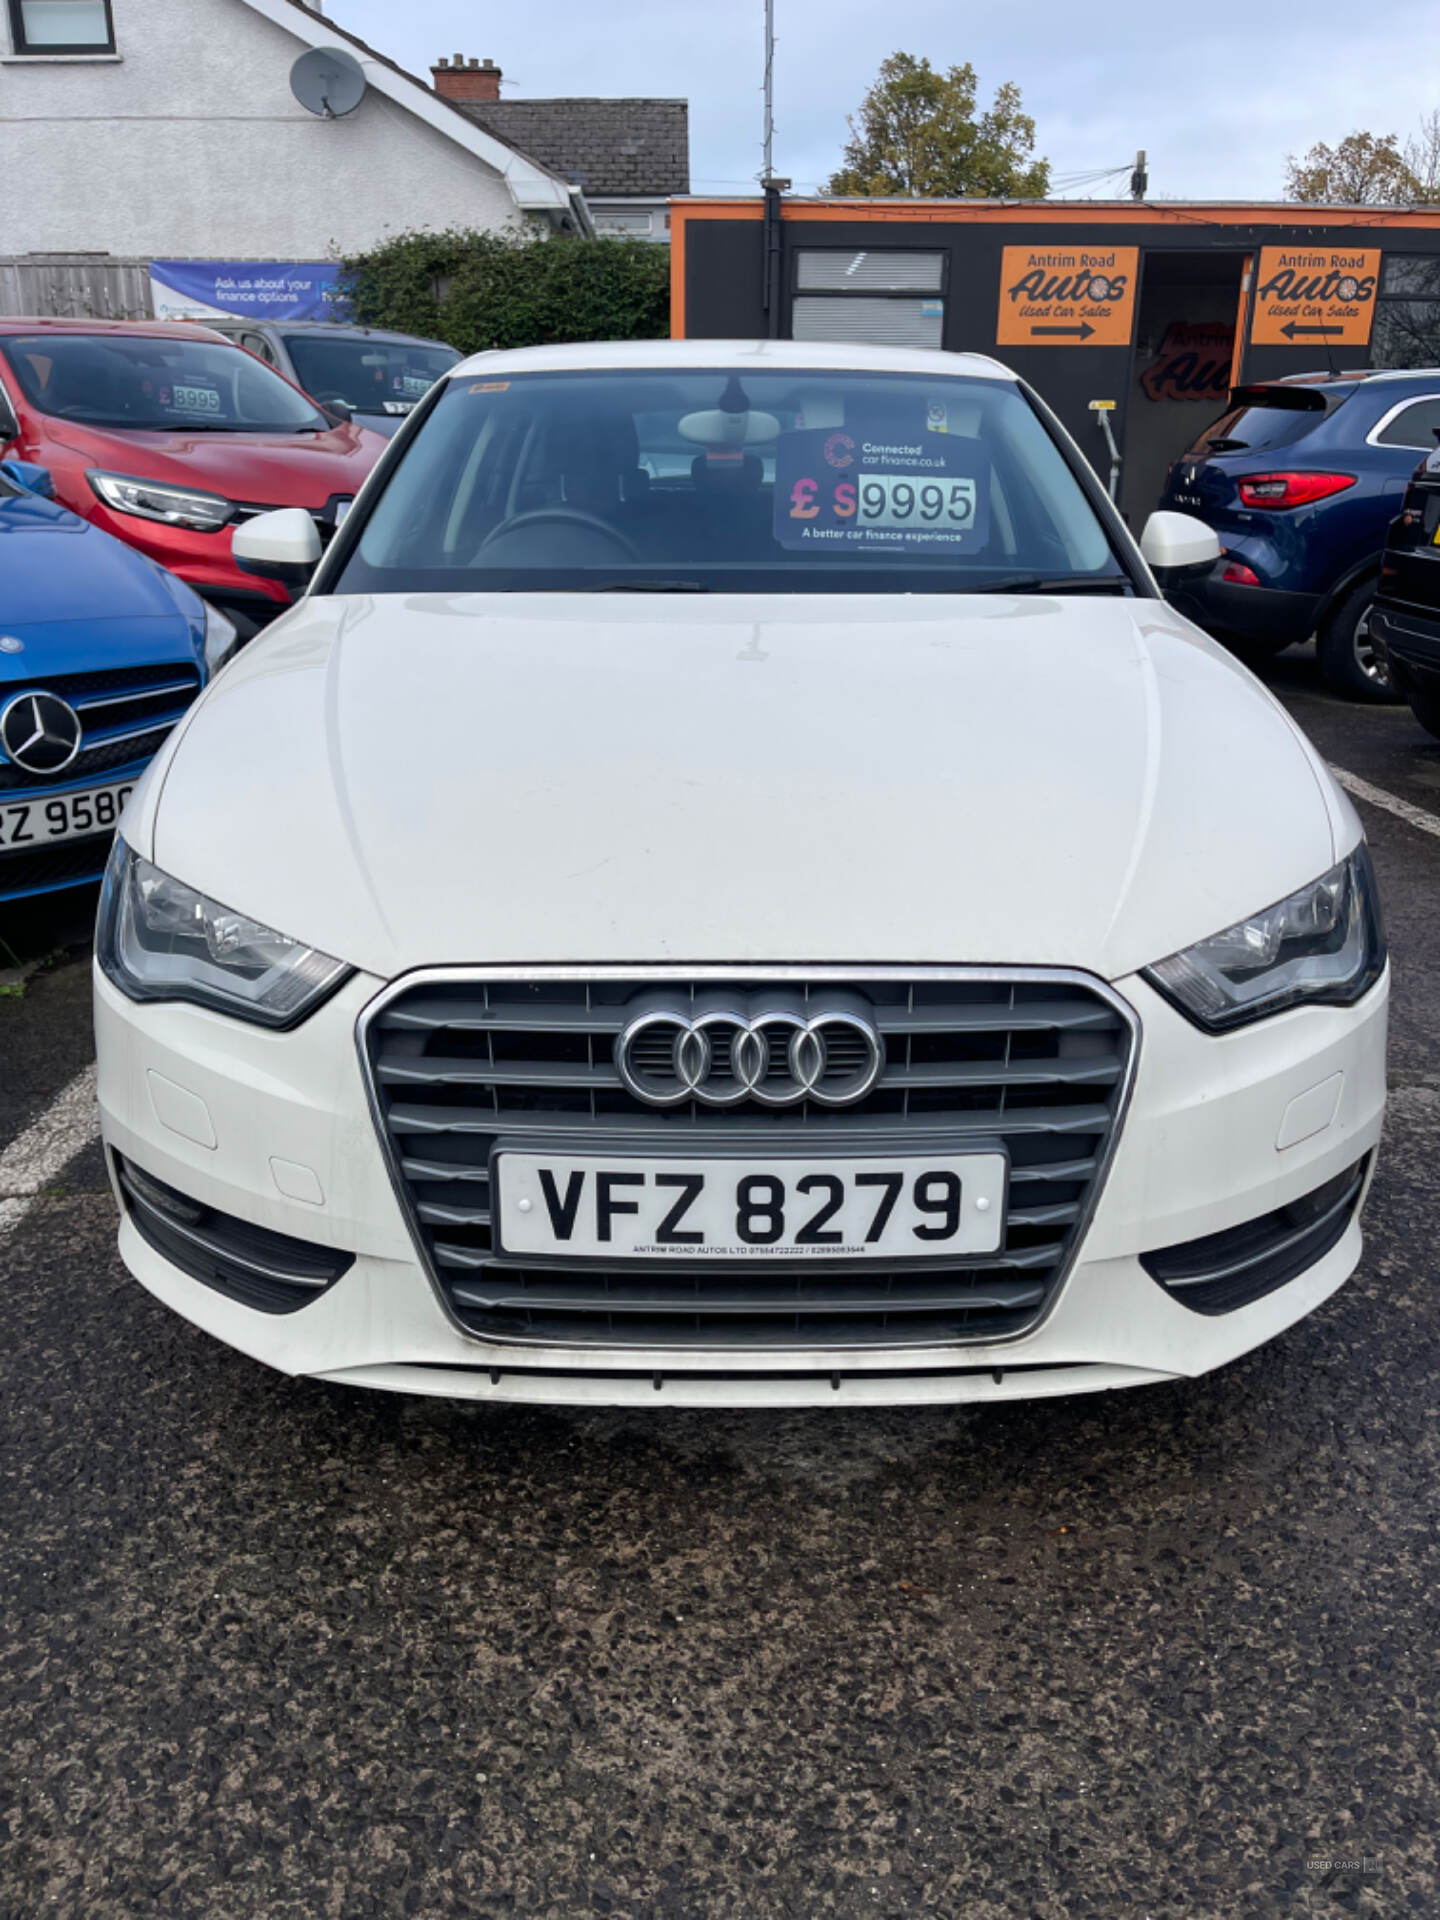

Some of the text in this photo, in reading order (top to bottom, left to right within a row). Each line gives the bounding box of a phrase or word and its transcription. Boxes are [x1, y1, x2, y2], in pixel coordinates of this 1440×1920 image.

[1028, 253, 1115, 267] Antrim Road
[1280, 254, 1365, 268] Antrim Road
[215, 277, 236, 288] Ask
[238, 279, 252, 288] us
[254, 278, 285, 289] about
[288, 280, 311, 291] your
[1008, 268, 1128, 302] Autos
[1258, 268, 1376, 302] Autos
[216, 290, 299, 303] finance options
[1019, 305, 1112, 317] Used Car Sales
[1268, 305, 1359, 317] Used Car Sales
[175, 389, 219, 409] 8995
[862, 442, 922, 456] Connected
[790, 478, 820, 519] £
[862, 483, 972, 521] 9995
[802, 528, 962, 543] A better car finance experience
[0, 806, 33, 845] Z
[538, 1169, 961, 1243] VFZ 8279
[633, 1245, 667, 1253] ANTRIM
[669, 1246, 696, 1254] ROAD
[698, 1246, 727, 1254] AUTOS
[729, 1247, 747, 1255] LTD
